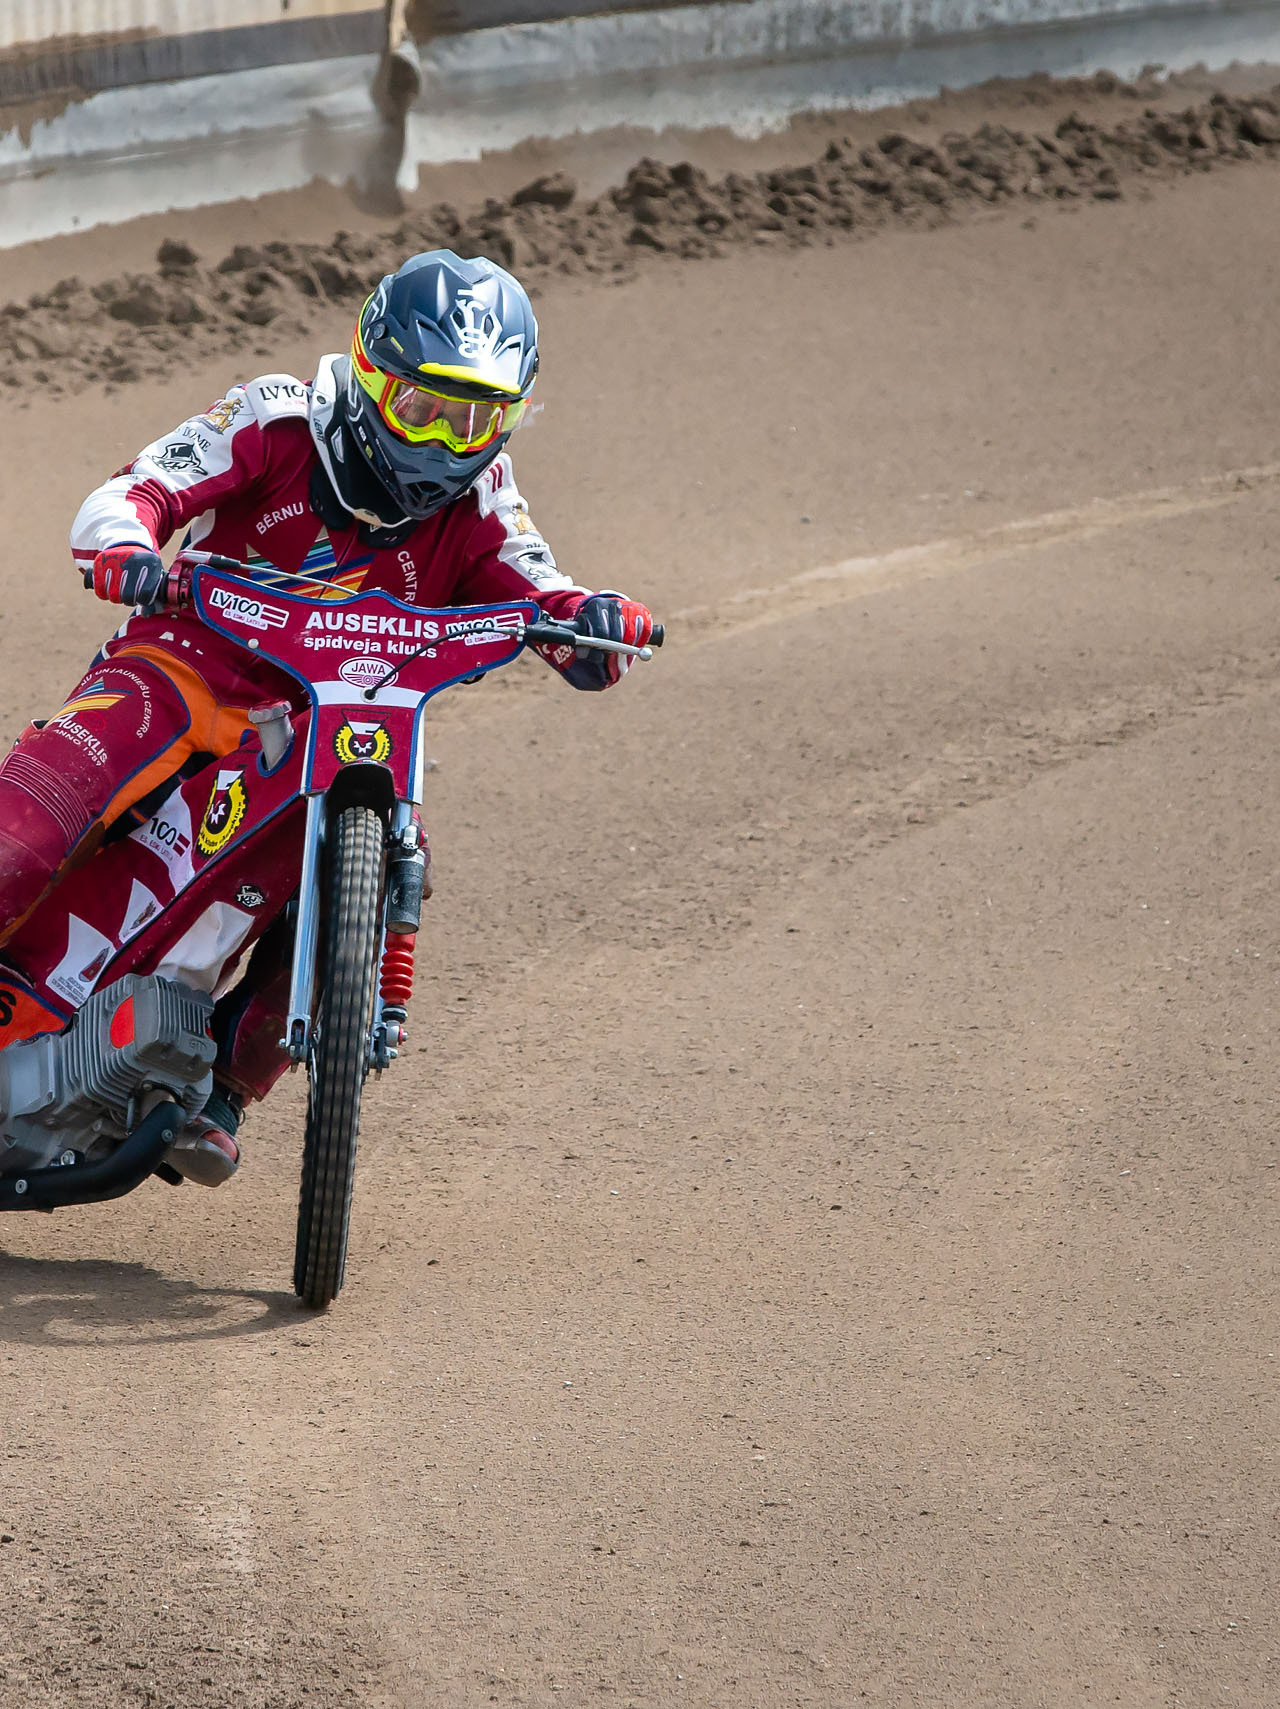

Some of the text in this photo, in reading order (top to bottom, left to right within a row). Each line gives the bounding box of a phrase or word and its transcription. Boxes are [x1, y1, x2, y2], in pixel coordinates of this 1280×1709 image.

[255, 501, 304, 536] BĒRNU
[305, 611, 439, 640] AUSEKLIS
[303, 635, 438, 659] spīdveja klubs
[351, 662, 386, 675] JAWA
[136, 700, 152, 739] CENTRS
[52, 711, 108, 765] AUSEKLIS
[53, 729, 82, 746] ANNO
